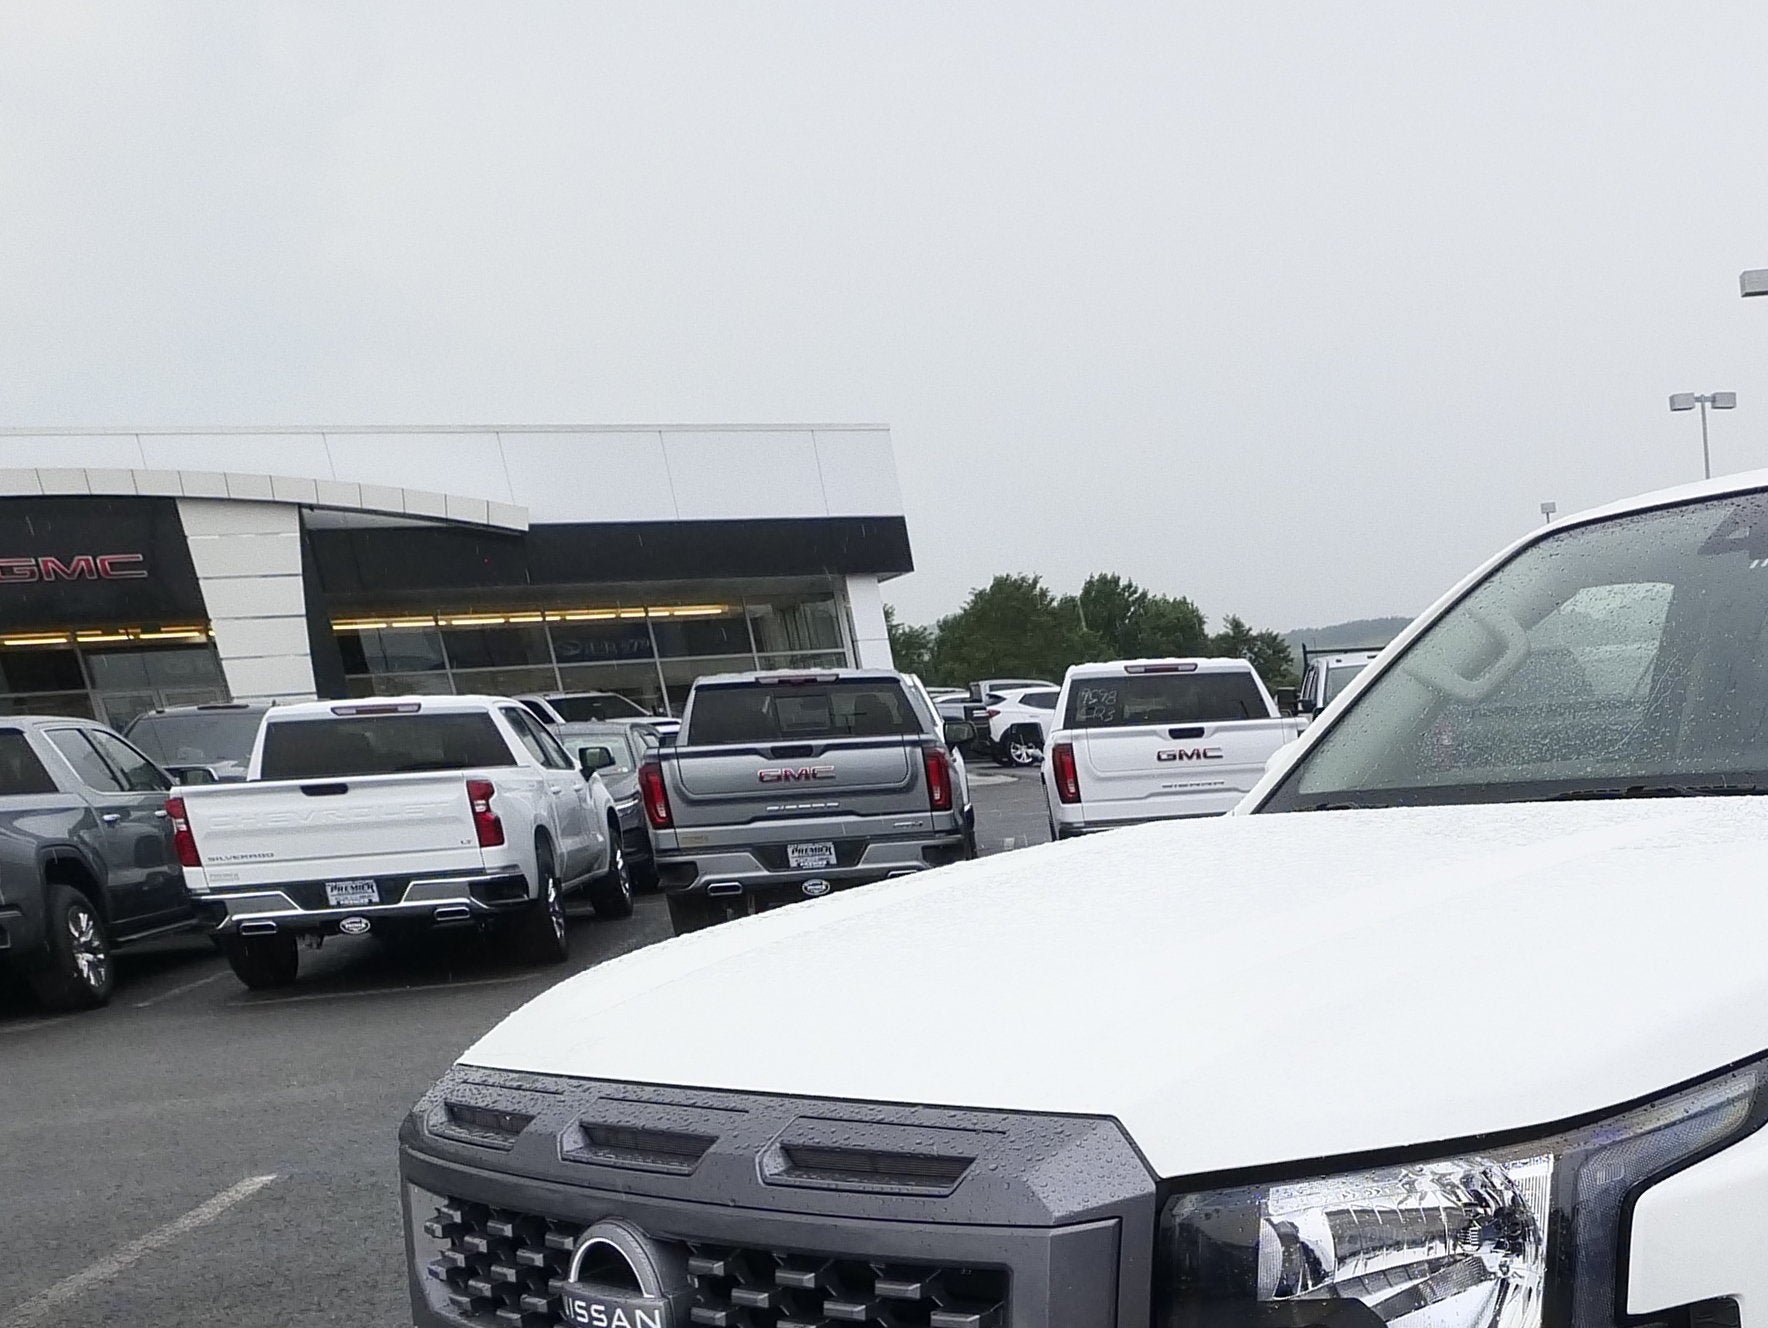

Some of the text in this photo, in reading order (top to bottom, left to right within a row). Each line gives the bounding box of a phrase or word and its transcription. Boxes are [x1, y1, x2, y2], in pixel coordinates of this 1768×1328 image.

[0, 554, 148, 583] GMC
[1156, 747, 1224, 762] GMC
[757, 765, 837, 783] GMC
[207, 852, 275, 862] SILVERADO
